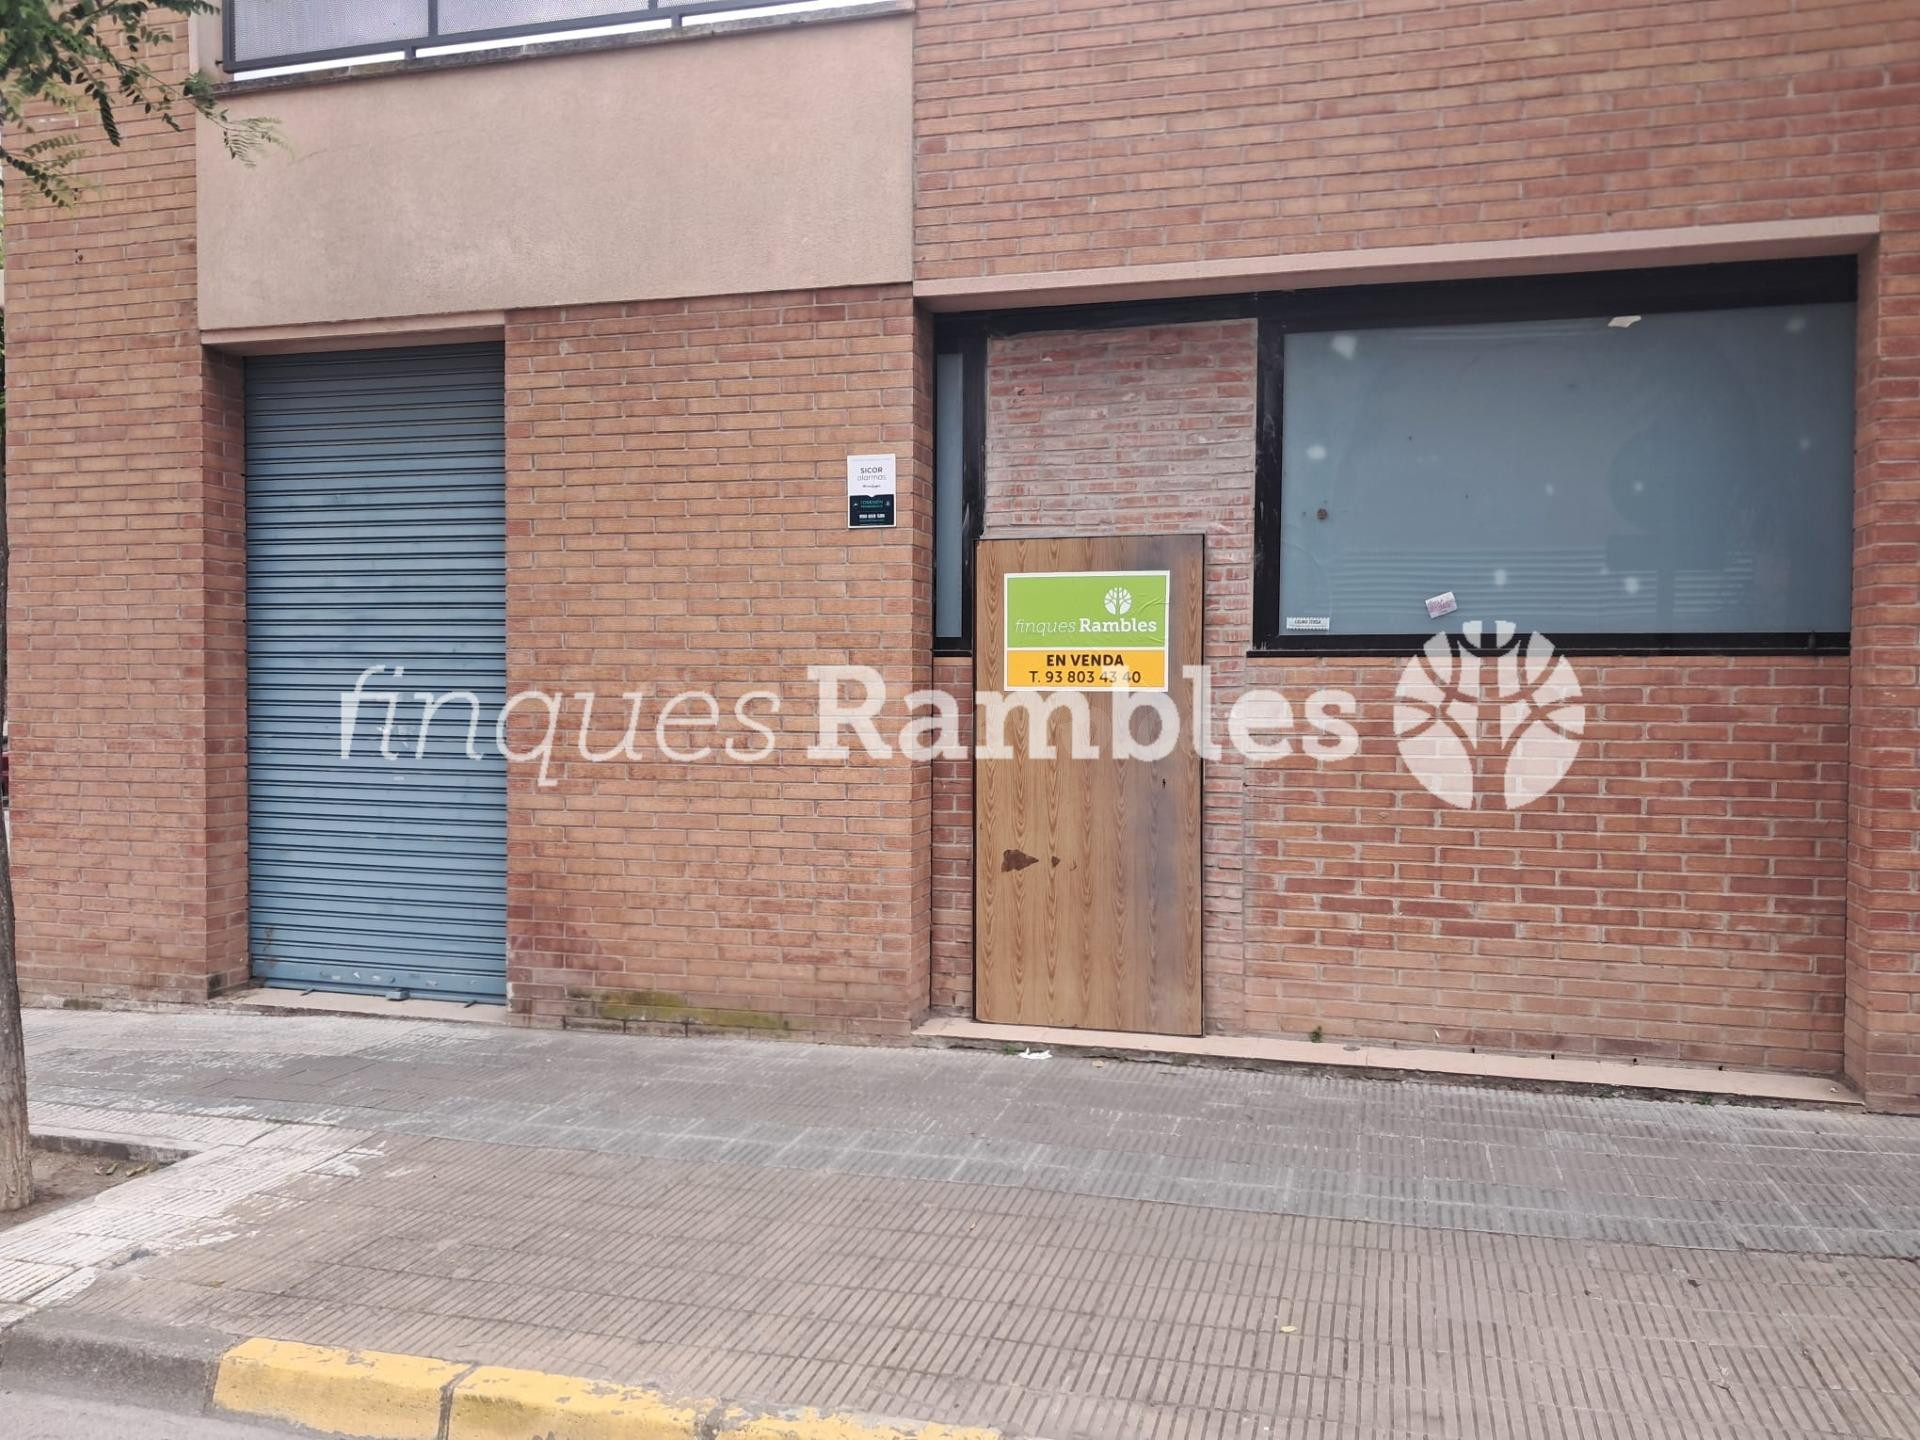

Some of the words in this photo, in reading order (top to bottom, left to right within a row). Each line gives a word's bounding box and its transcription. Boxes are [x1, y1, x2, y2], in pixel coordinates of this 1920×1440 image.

[860, 466, 883, 474] SICOR
[1015, 618, 1076, 637] finques
[1079, 617, 1157, 633] Rambles
[1046, 654, 1066, 667] EN
[1070, 654, 1124, 666] VENDA
[1029, 671, 1041, 683] T.
[1045, 671, 1063, 683] 93
[1067, 671, 1095, 683] 803
[1099, 671, 1117, 683] 43
